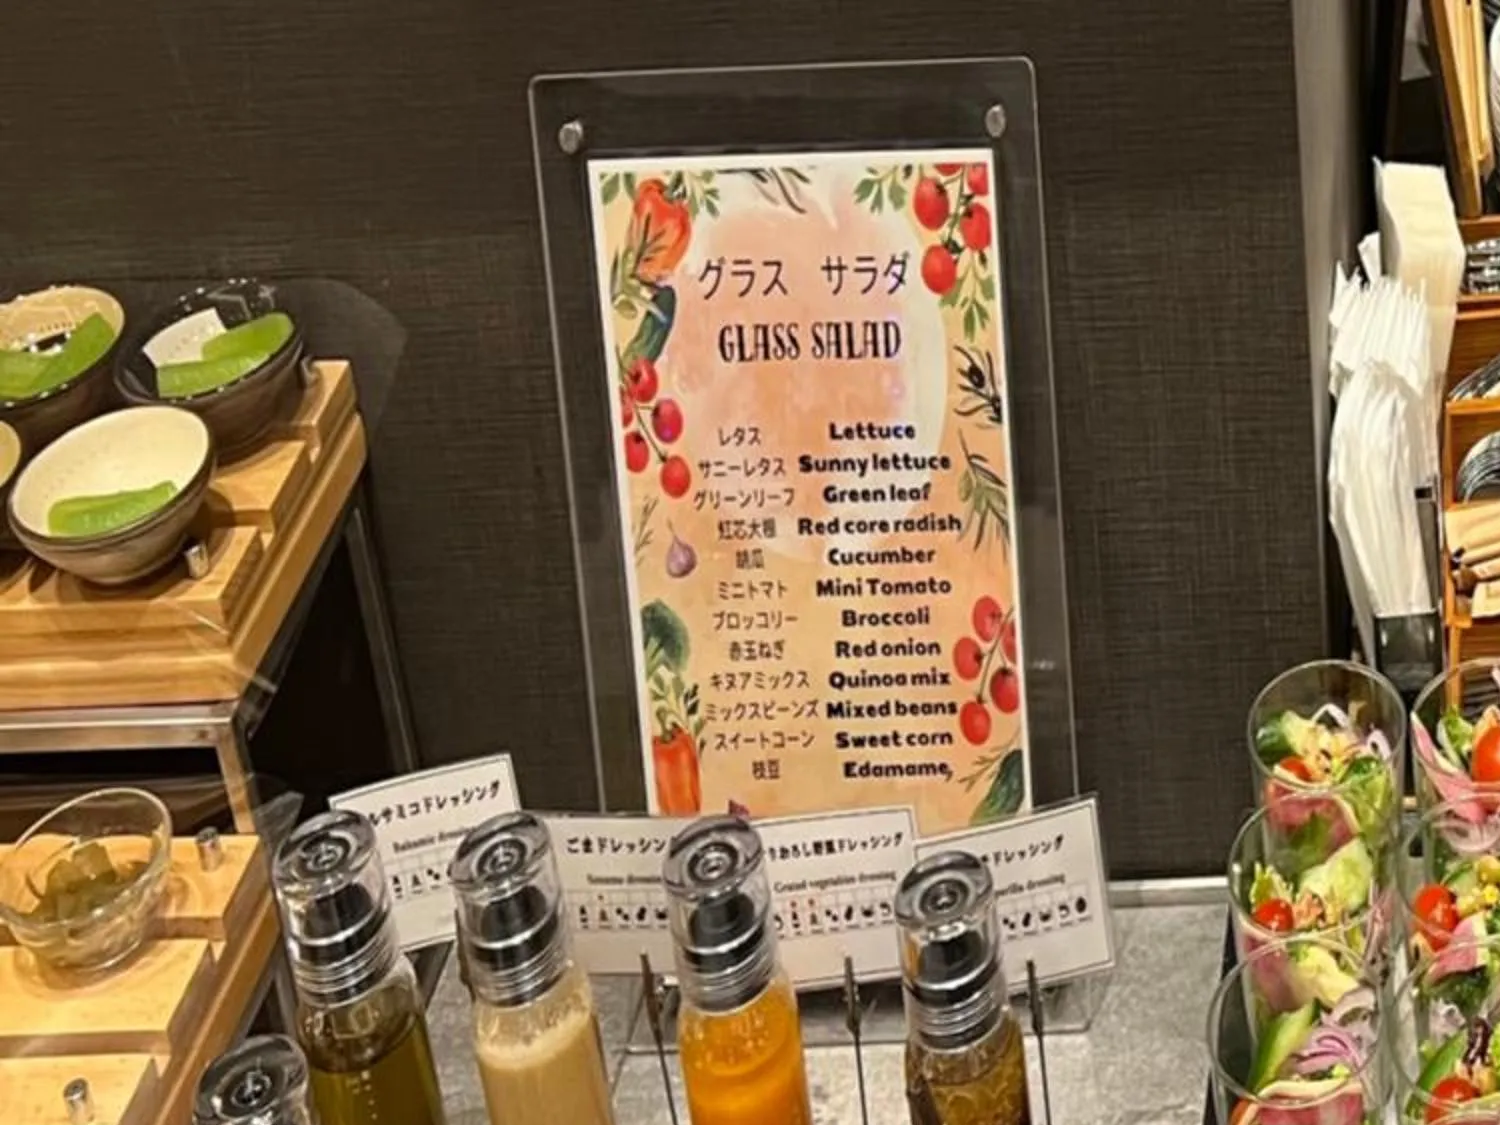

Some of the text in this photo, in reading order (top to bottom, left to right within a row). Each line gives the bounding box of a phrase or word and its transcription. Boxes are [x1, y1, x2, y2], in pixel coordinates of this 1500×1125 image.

[699, 252, 910, 299] グラス サラダ
[719, 320, 900, 362] GLASS SALAD
[718, 426, 761, 446] レタス
[829, 422, 916, 441] Lettuce
[699, 457, 785, 478] サニーレタス
[798, 454, 951, 478] Sunny lettuce
[694, 487, 795, 510] グリーンリーフ
[823, 482, 931, 503] Green leaf
[798, 516, 962, 536] Red core radish
[828, 547, 936, 565] Cucumber
[718, 580, 788, 601] ミニトマト
[816, 578, 952, 598] Mini Tomato
[712, 611, 798, 631] ブロッコリー
[842, 609, 930, 627] Broccoli
[835, 638, 941, 658] Red onion
[710, 672, 811, 691] キヌアミックス
[829, 668, 951, 690] Quinoa mix
[704, 701, 820, 721] ミックスビーンズ
[826, 699, 958, 719] Mixed beans
[714, 730, 816, 750] スイートコーン
[835, 729, 953, 750] Sweet corn
[843, 760, 949, 778] Edamame
[368, 779, 501, 826] ルサミコドレッシング
[567, 836, 668, 854] ごまドレッシン
